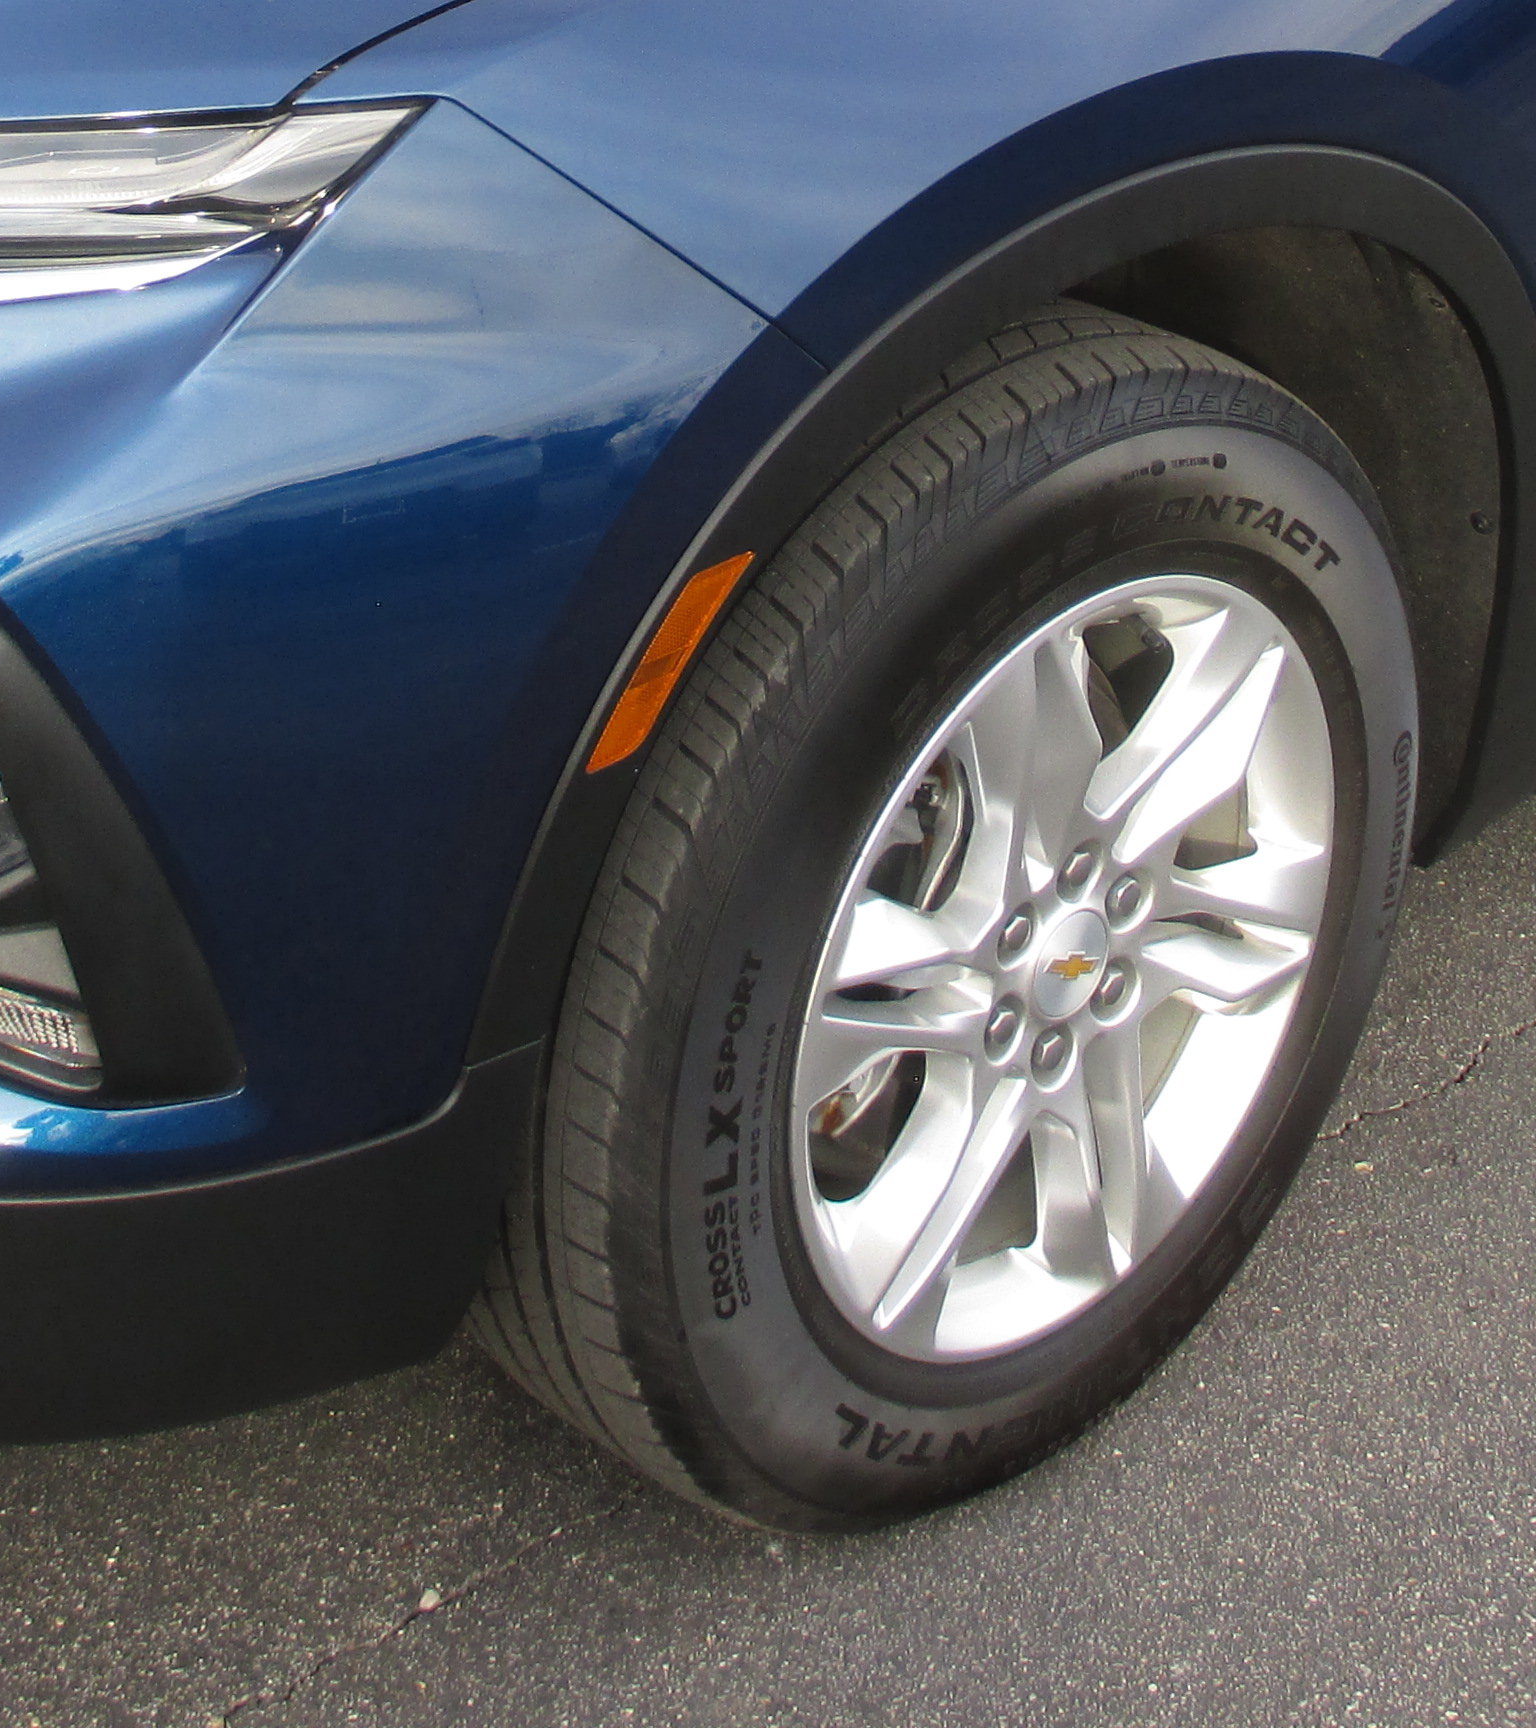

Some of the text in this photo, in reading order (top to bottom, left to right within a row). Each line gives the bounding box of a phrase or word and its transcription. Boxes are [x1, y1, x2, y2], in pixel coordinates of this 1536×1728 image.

[1112, 493, 1341, 572] CONTACT
[713, 949, 764, 1094] SPORT
[703, 1097, 744, 1196] LX
[704, 1202, 737, 1321] CROSS
[727, 1194, 752, 1308] CONTACT
